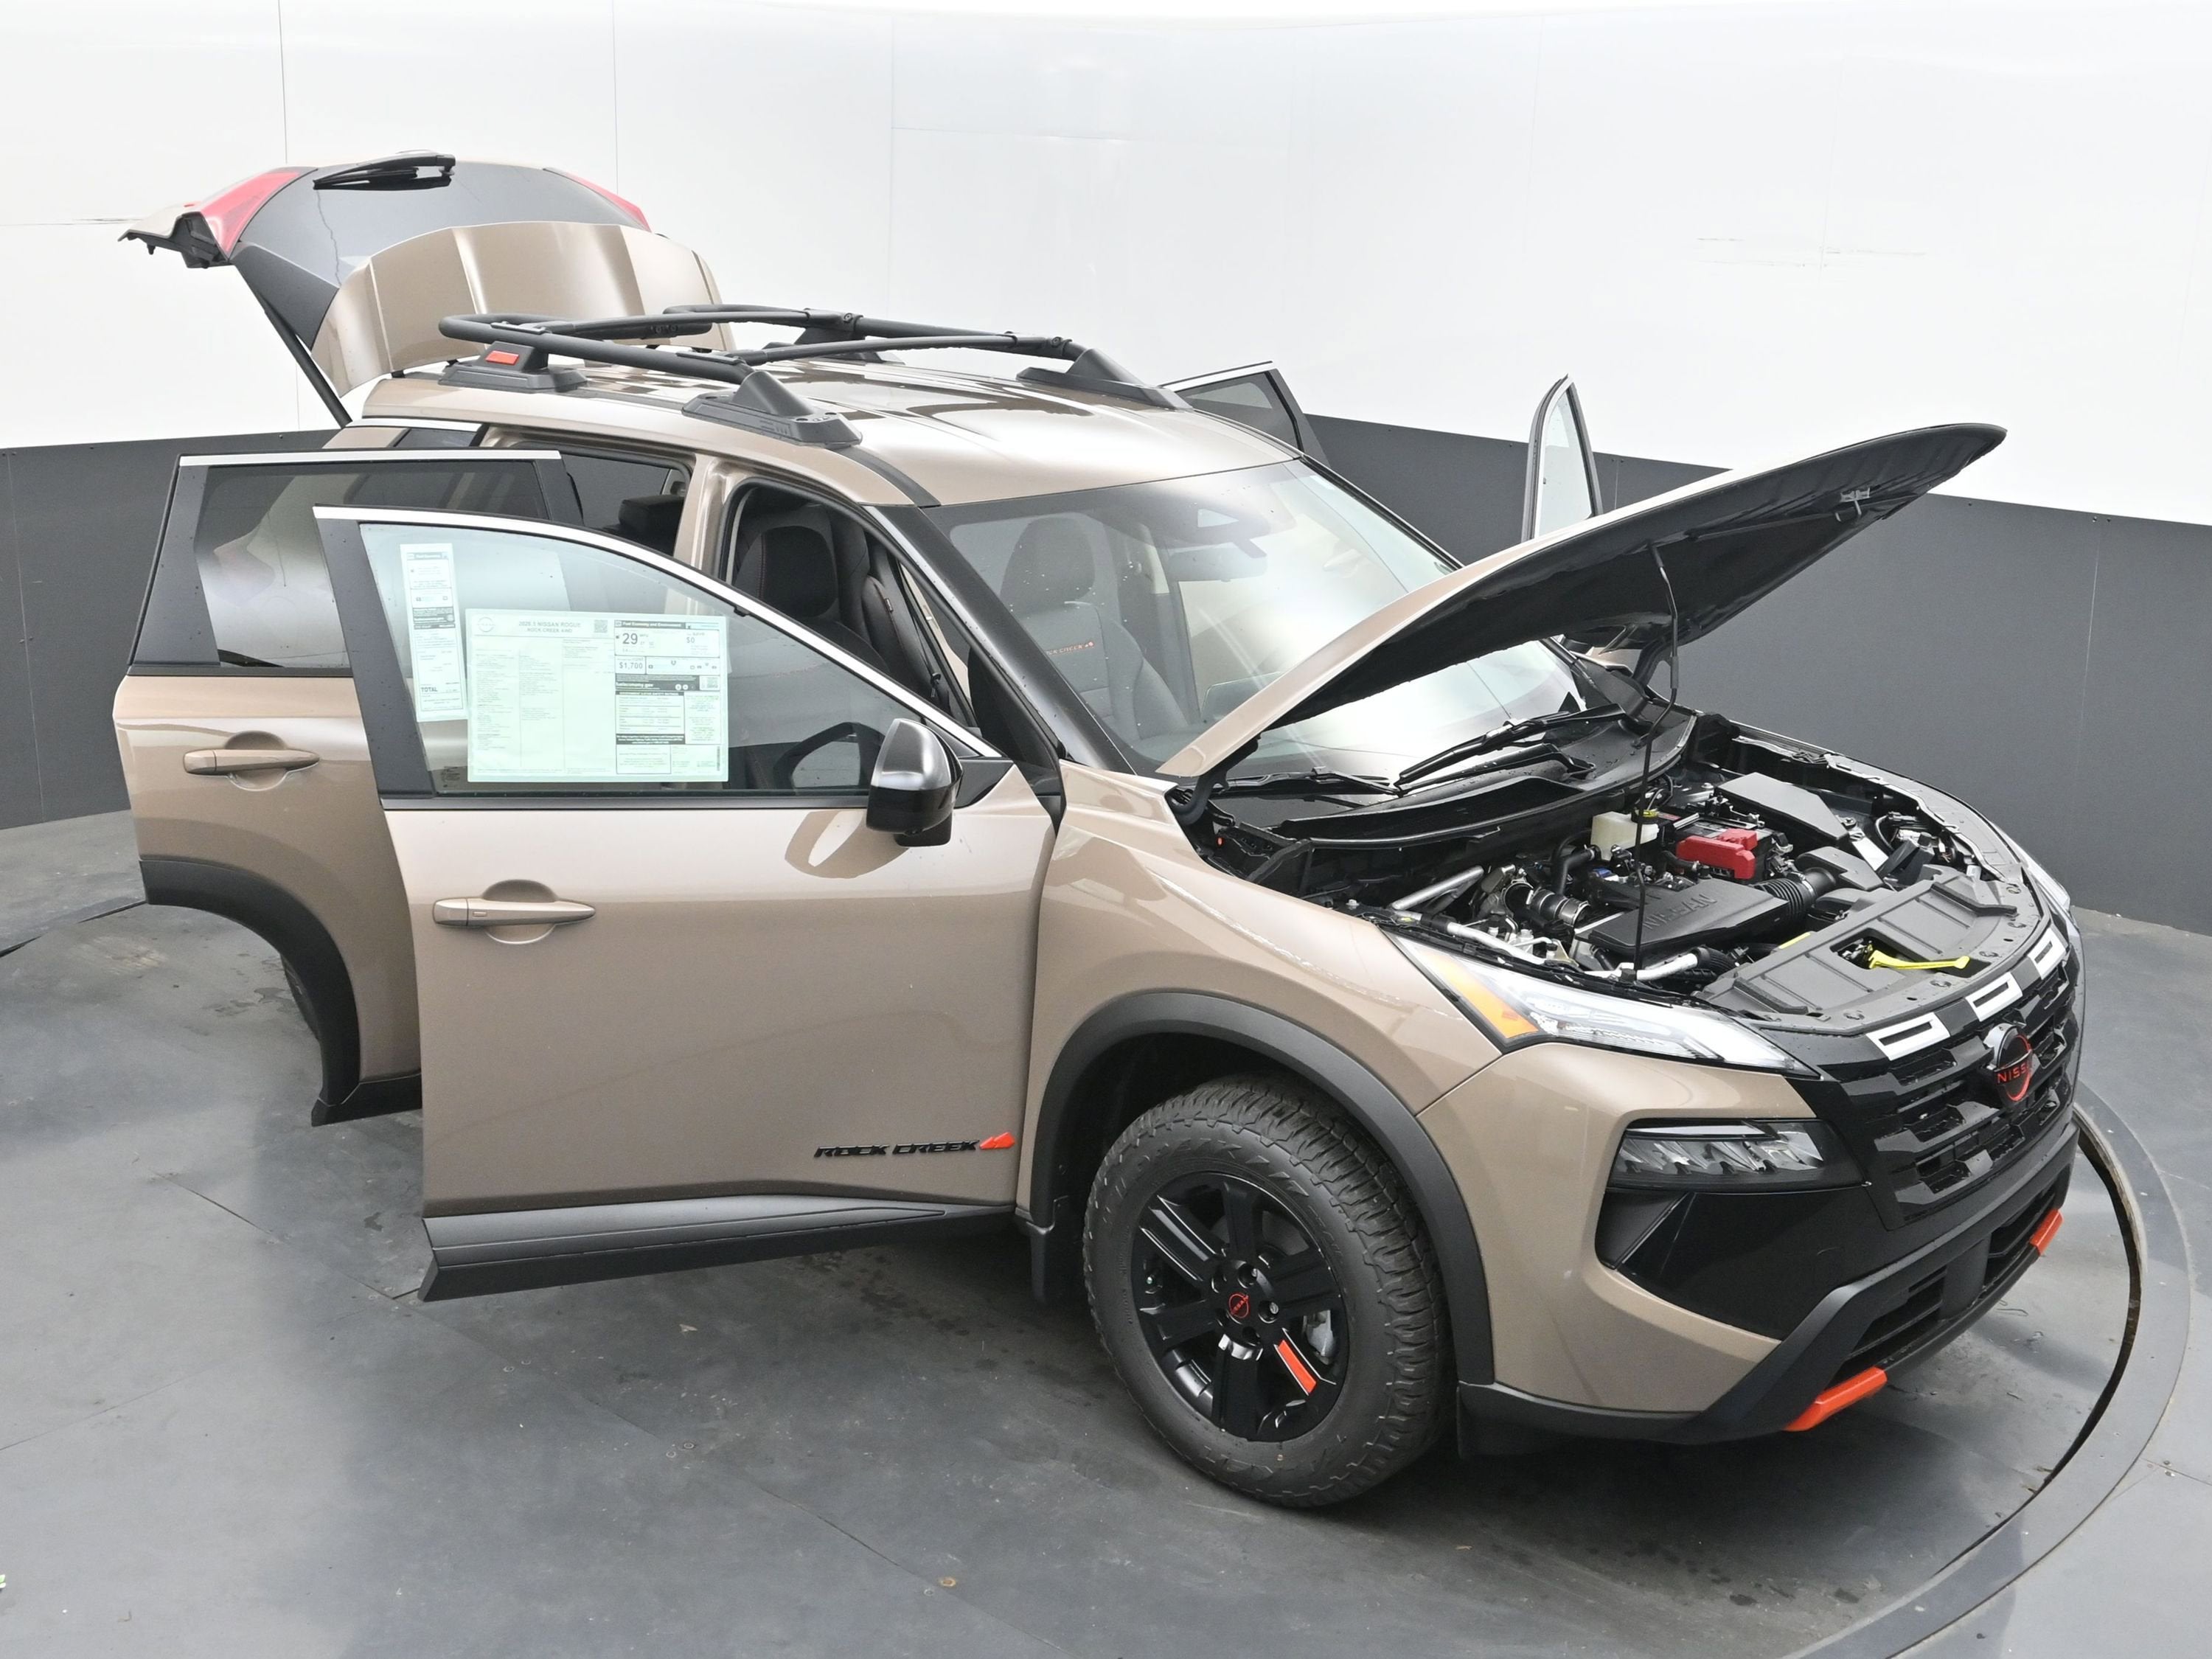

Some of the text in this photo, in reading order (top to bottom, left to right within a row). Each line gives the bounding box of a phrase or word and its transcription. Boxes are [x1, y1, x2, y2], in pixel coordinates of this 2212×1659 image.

[622, 633, 639, 645] 29
[619, 661, 643, 670] $1,700
[1997, 1062, 2031, 1085] NISS
[813, 1139, 980, 1158] ROCK CREEK
